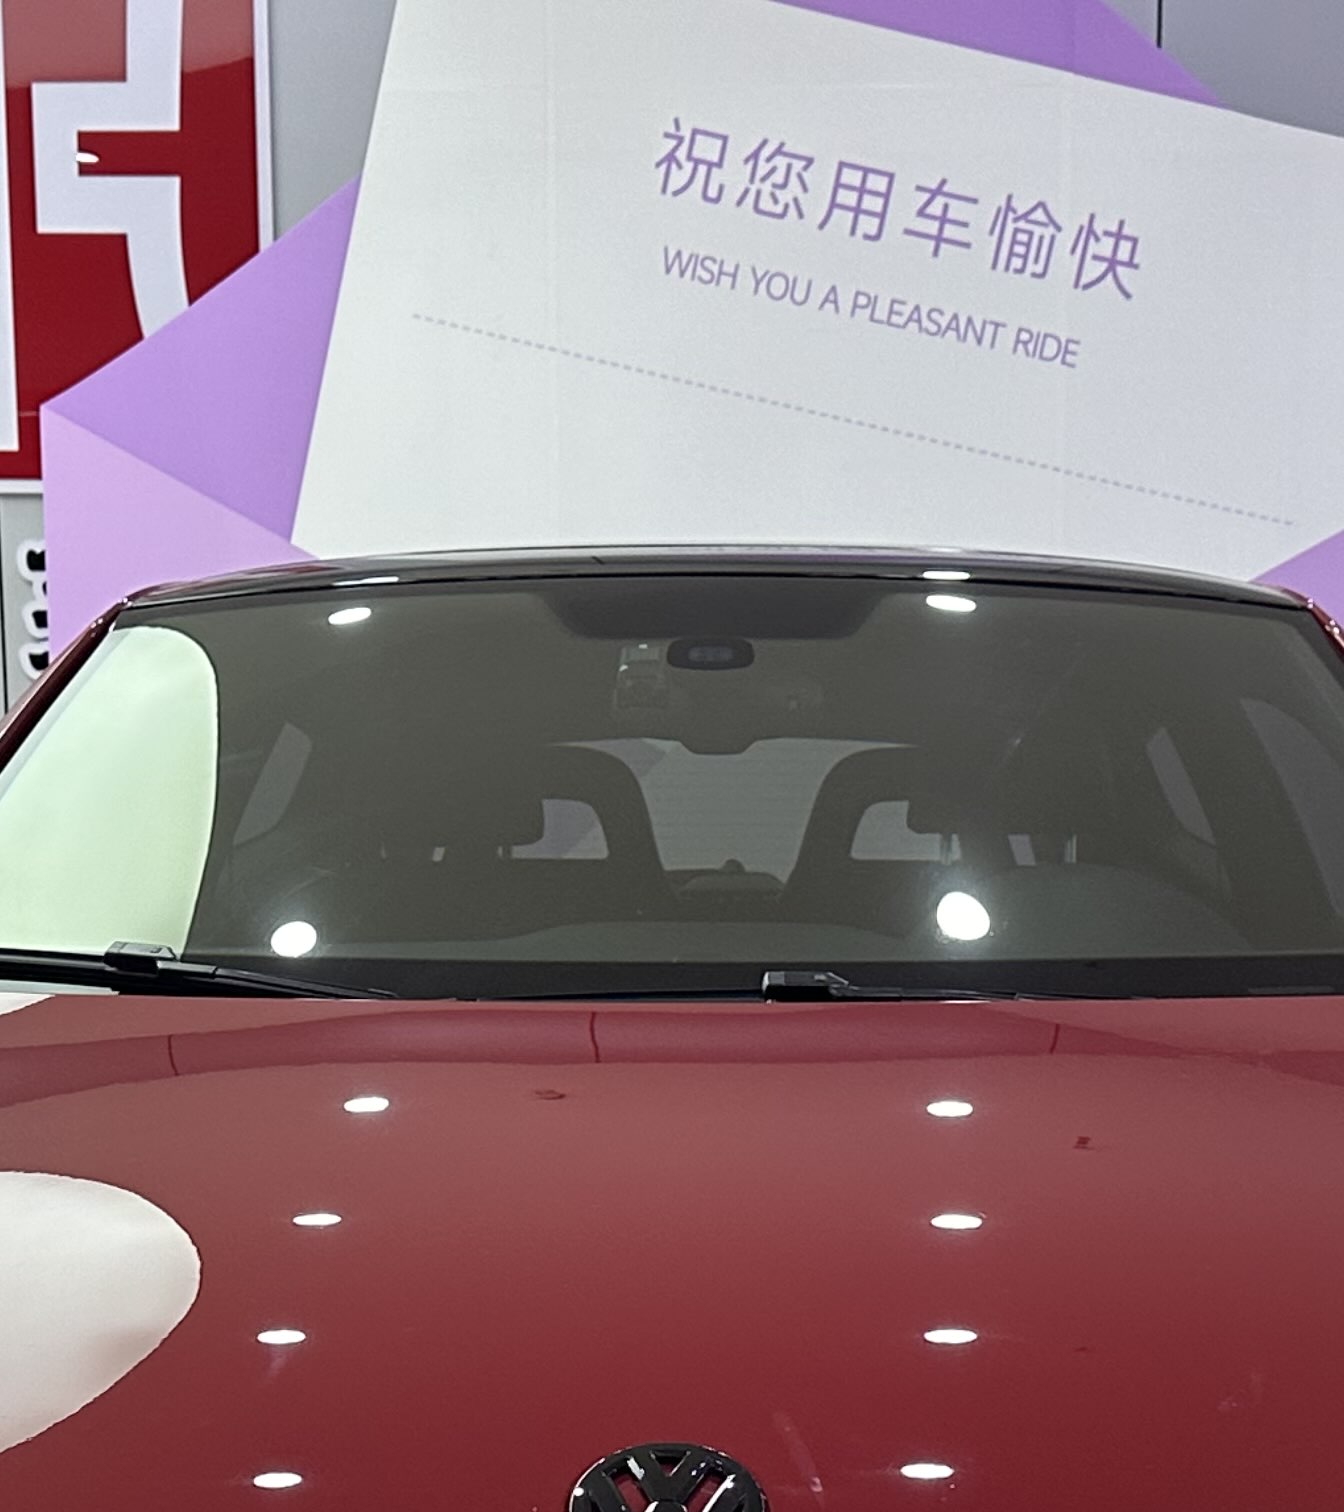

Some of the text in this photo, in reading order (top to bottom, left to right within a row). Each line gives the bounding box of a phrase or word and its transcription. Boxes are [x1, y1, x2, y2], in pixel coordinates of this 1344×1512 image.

[653, 116, 1141, 300] 祝您用车愉快
[662, 245, 1082, 369] WISH YOU A PLEASANT RIDE
